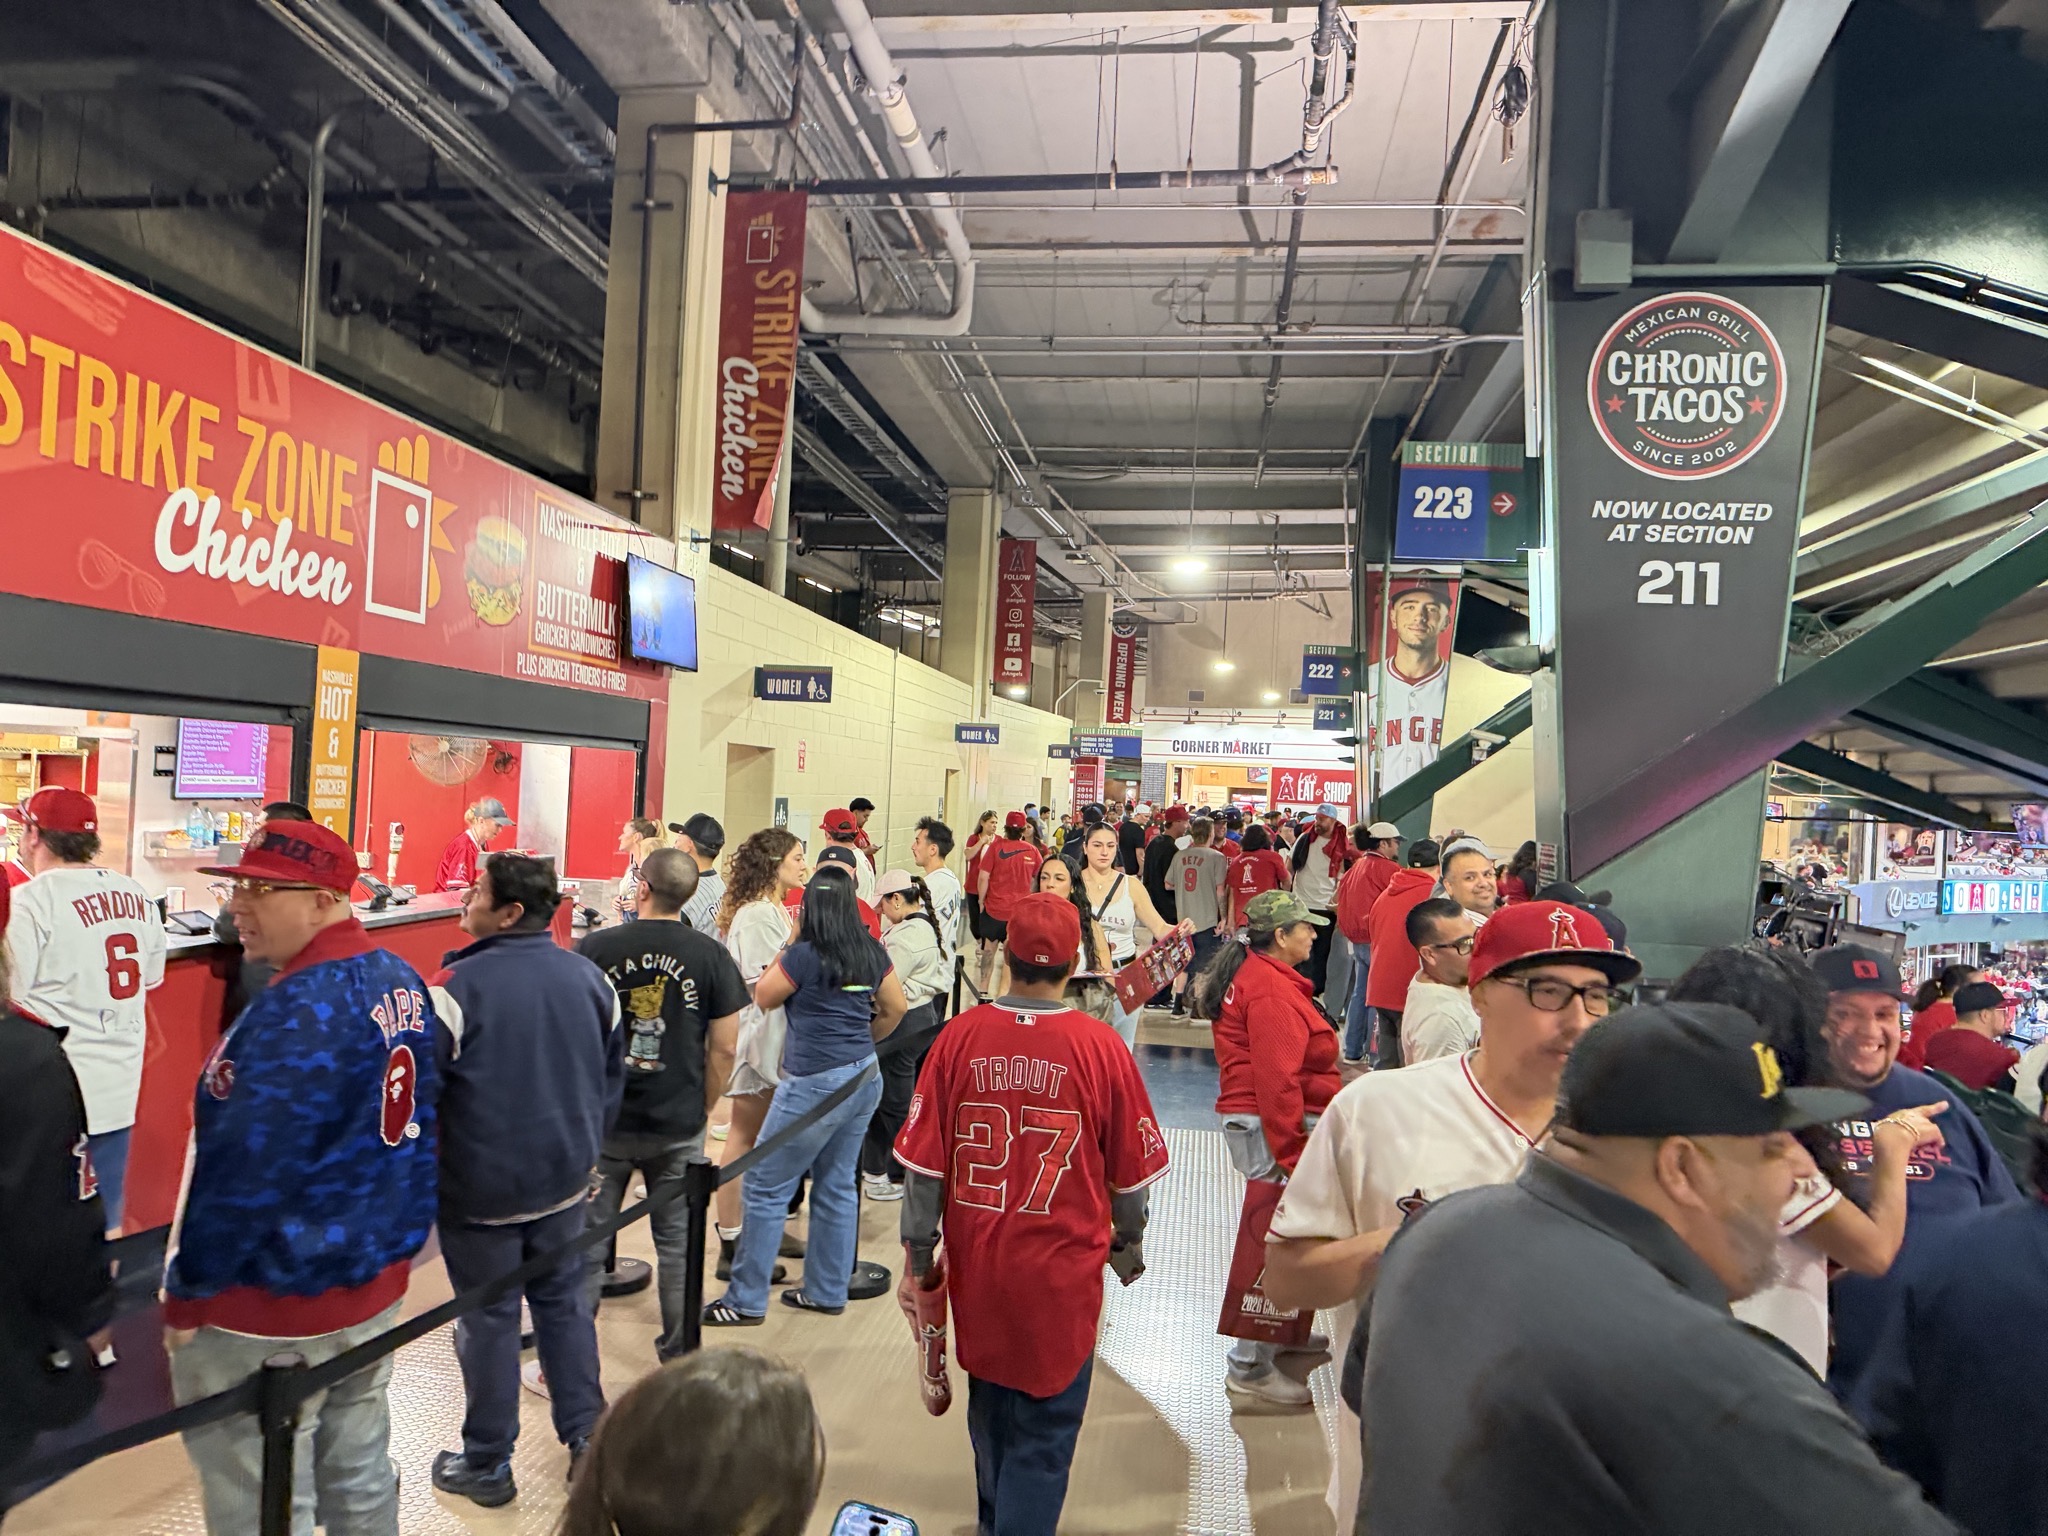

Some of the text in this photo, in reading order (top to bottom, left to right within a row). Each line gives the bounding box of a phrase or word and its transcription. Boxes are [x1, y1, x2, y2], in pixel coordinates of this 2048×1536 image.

[752, 269, 796, 390] STRIKE
[1624, 307, 1752, 344] MEXICAN GRILL
[1607, 350, 1768, 387] CHRONIC
[1627, 386, 1745, 424] TACOS
[0, 320, 357, 546] STRIKE ZONE
[722, 356, 760, 501] Chicken
[1415, 445, 1478, 463] SECTION
[1632, 440, 1738, 465] SINCE 2002
[1413, 486, 1473, 520] 223
[1591, 500, 1773, 522] NOW LOCATED
[154, 487, 353, 605] Chicken
[539, 502, 620, 564] NASHVILLE HOT
[1607, 524, 1754, 544] AT SECTION
[577, 557, 585, 586] &
[1637, 560, 1721, 606] 211
[537, 580, 617, 637] BUTTERMILK
[535, 621, 616, 659] CHICKEN SANDWICHES
[1309, 646, 1336, 655] SECTION
[517, 652, 627, 692] PLUS CHICKEN TENDERS & FRIES!
[767, 677, 802, 696] WOMEN
[1112, 642, 1128, 721] OPENING WEEK
[1308, 663, 1334, 679] 222
[320, 686, 353, 722] HOT
[1318, 709, 1334, 721] 221
[328, 727, 340, 759] &
[961, 730, 982, 740] WOMEN
[1172, 738, 1272, 756] CORNER MARKET
[315, 779, 347, 796] CHICKEN
[1298, 781, 1315, 801] EAT
[1323, 781, 1352, 803] SHOP
[1299, 773, 1317, 785] Let's
[1182, 856, 1205, 867] NETO
[1184, 868, 1197, 892] 9
[71, 890, 146, 928] RENDON
[1903, 892, 1938, 909] LEXUS
[105, 932, 142, 1001] 6
[625, 958, 638, 975] A
[642, 953, 686, 982] CHILL
[681, 978, 700, 1011] GUY
[970, 1055, 1068, 1099] TROUT
[954, 1102, 1082, 1215] 27
[1241, 1293, 1264, 1314] 2026
